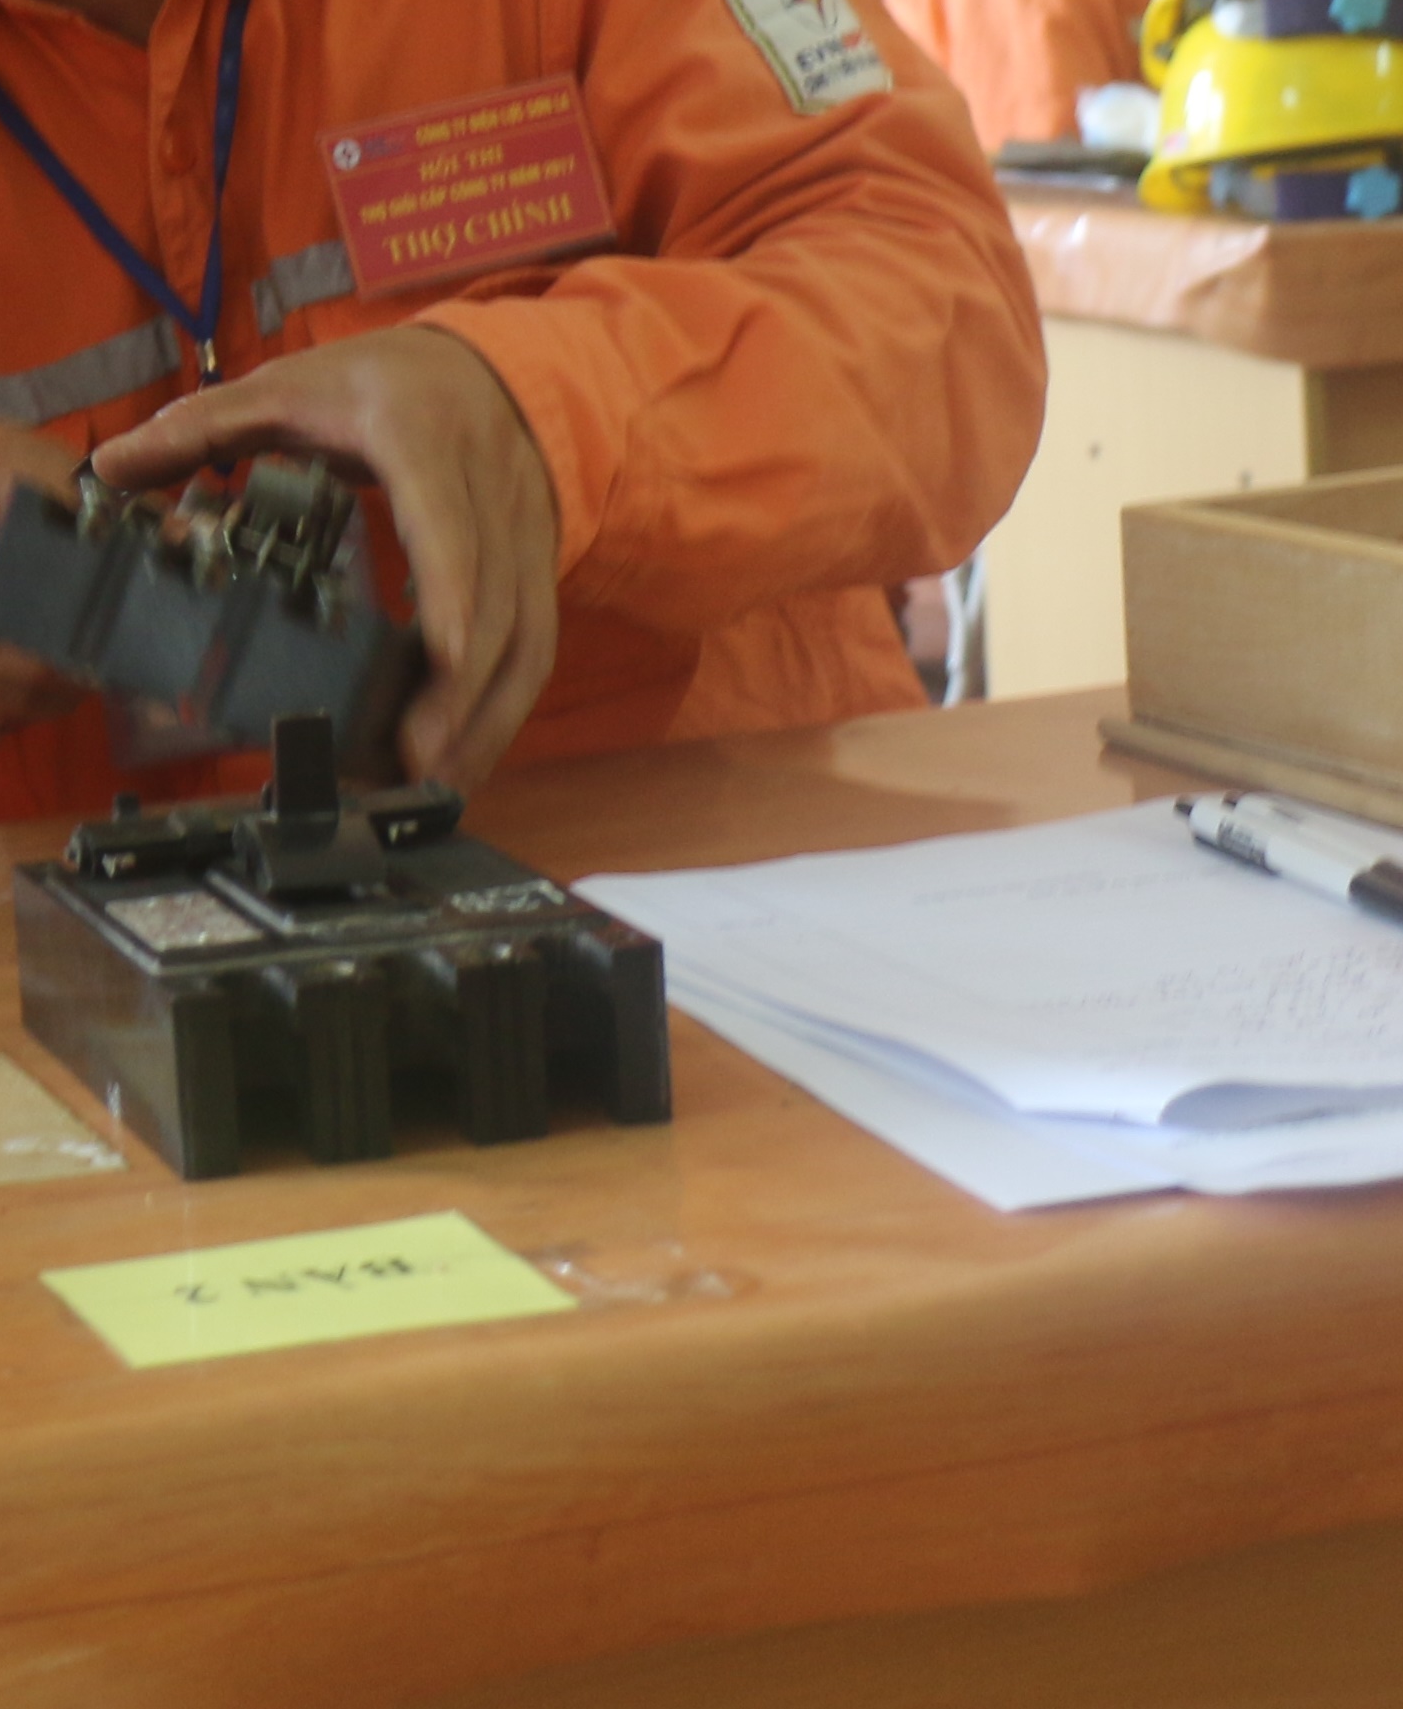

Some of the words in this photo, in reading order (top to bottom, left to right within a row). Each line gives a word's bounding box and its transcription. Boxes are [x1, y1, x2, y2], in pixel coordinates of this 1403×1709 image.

[465, 142, 504, 169] THI
[382, 219, 458, 265] THỢ
[462, 192, 573, 243] CHÍNH
